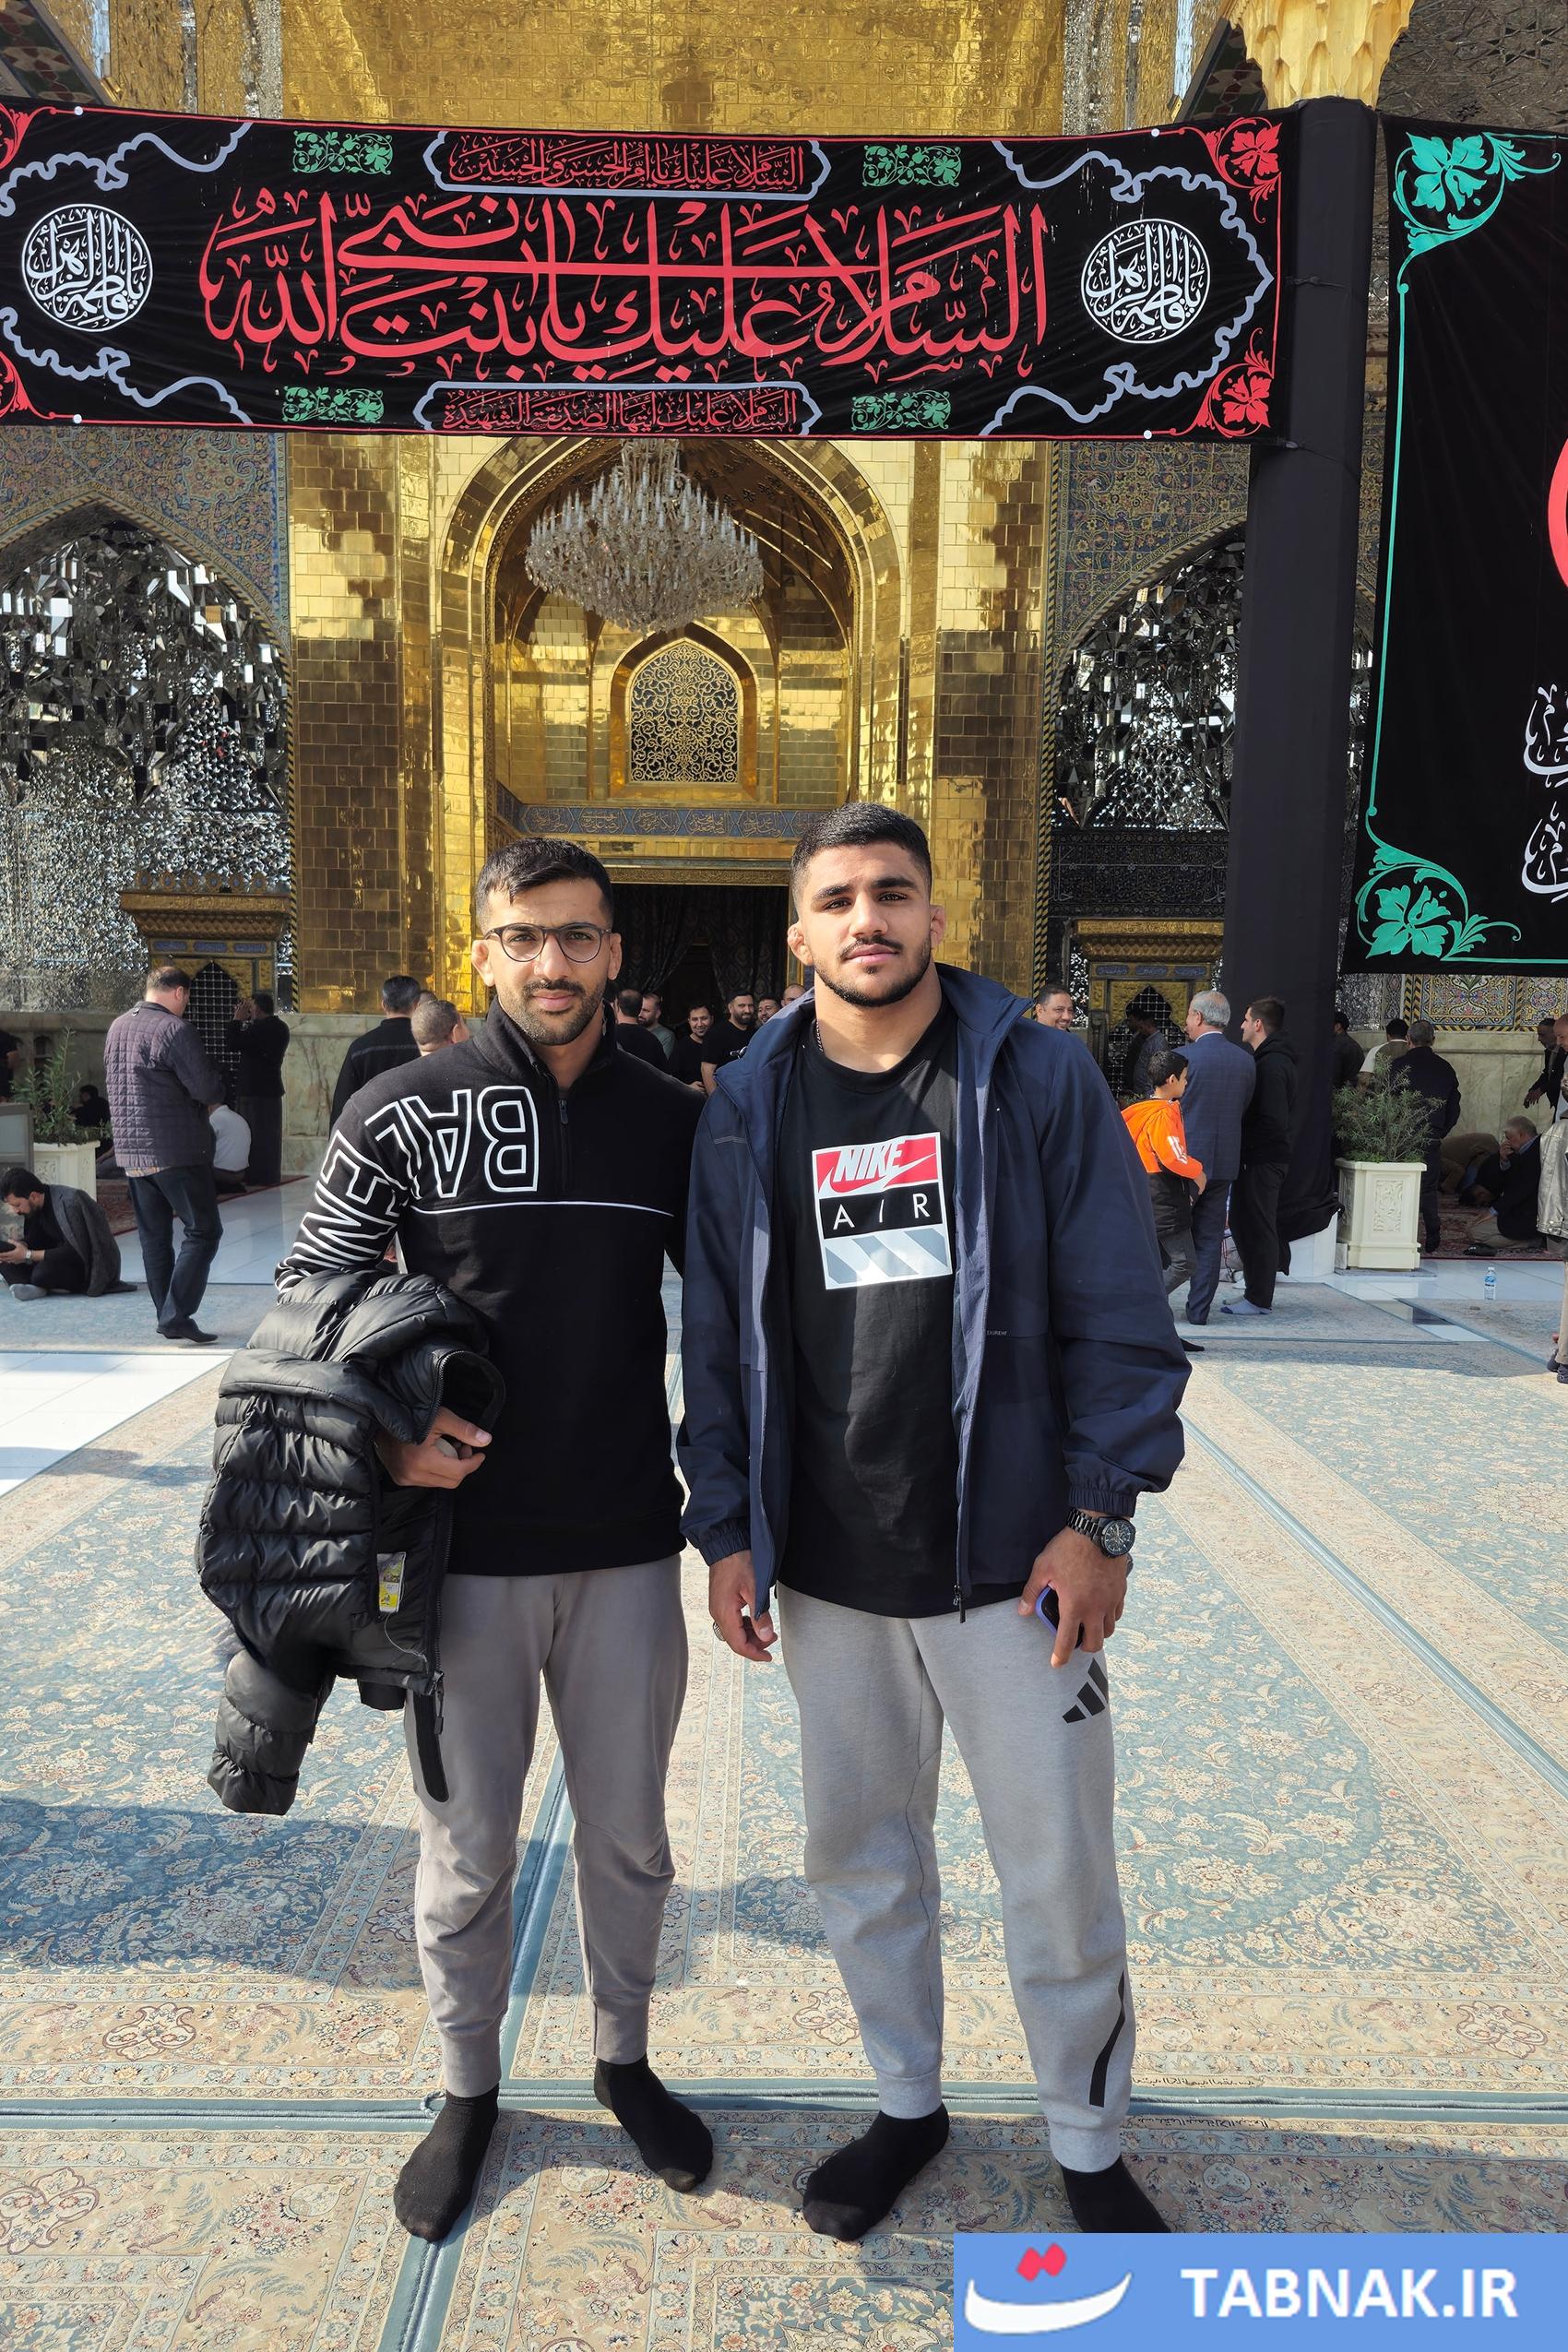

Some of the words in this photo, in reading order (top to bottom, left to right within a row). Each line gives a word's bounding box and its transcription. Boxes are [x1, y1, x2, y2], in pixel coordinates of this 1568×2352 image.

[833, 1139, 907, 1182] NIKE
[275, 1086, 539, 1293] BALEN
[833, 1193, 931, 1229] AIR
